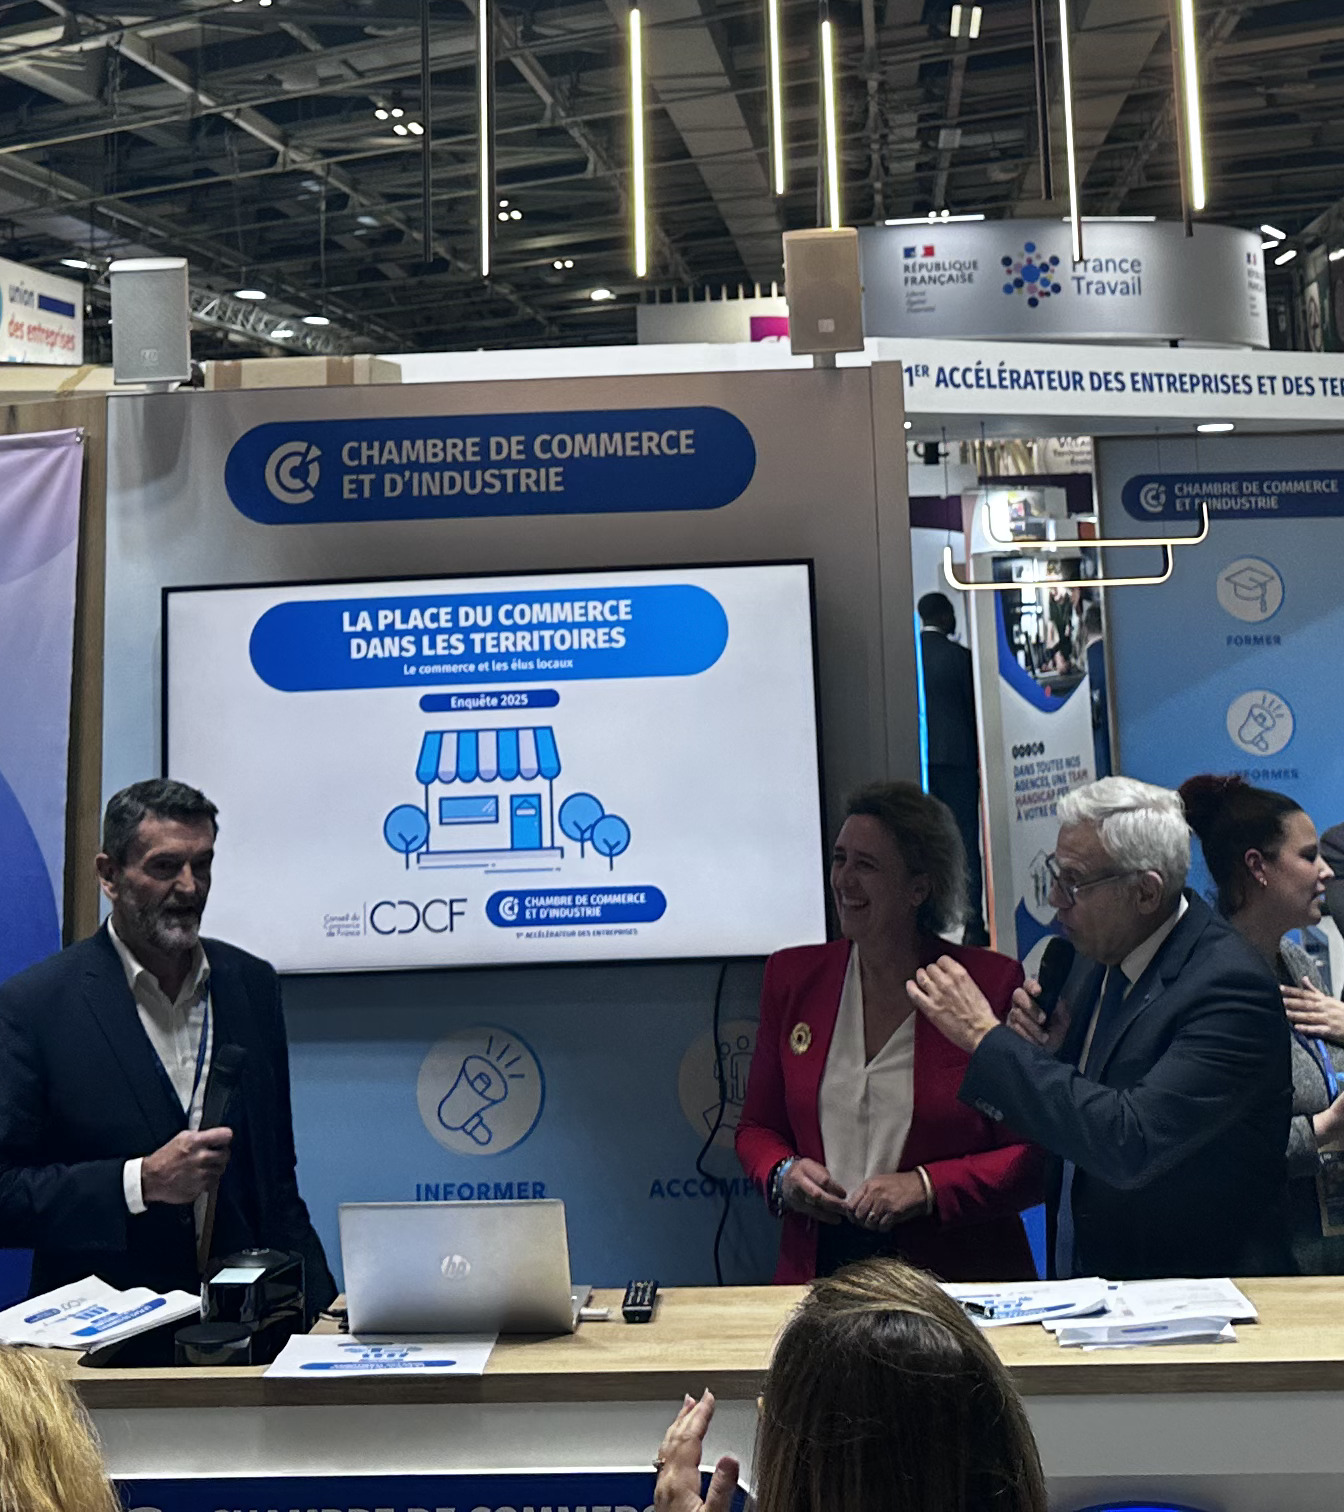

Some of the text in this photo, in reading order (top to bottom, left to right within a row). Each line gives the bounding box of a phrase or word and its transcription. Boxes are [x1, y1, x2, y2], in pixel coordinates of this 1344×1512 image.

[903, 259, 979, 274] RÉPUBLIQUE
[903, 271, 975, 287] FRANÇAISE
[1071, 276, 1143, 296] Travail
[8, 280, 35, 308] union
[7, 317, 76, 352] des entreprises
[935, 360, 1086, 392] ACCÉLÉRATEUR
[1089, 371, 1126, 392] DES
[1130, 372, 1253, 395] ENTREPRISES
[1257, 374, 1278, 395] ET
[1282, 375, 1316, 397] DES
[341, 429, 696, 467] CHAMBRE DE COMMERCE
[341, 466, 565, 500] ET D'INDUSTRIE
[1174, 478, 1340, 497] CHAMBRE DE COMMERCE
[1175, 497, 1191, 512] ET
[343, 599, 633, 633] LA PLACE DU COMMERCE
[349, 626, 627, 660] DANS LES TERRITOIRES
[1226, 634, 1282, 647] FORMER
[403, 658, 574, 676] Le commerce et les élus locaux
[450, 693, 529, 710] Enquête 2025
[524, 892, 647, 908] CHAMBRE DE COMMERCE
[525, 908, 537, 920] ET
[416, 1181, 548, 1202] INFORMER
